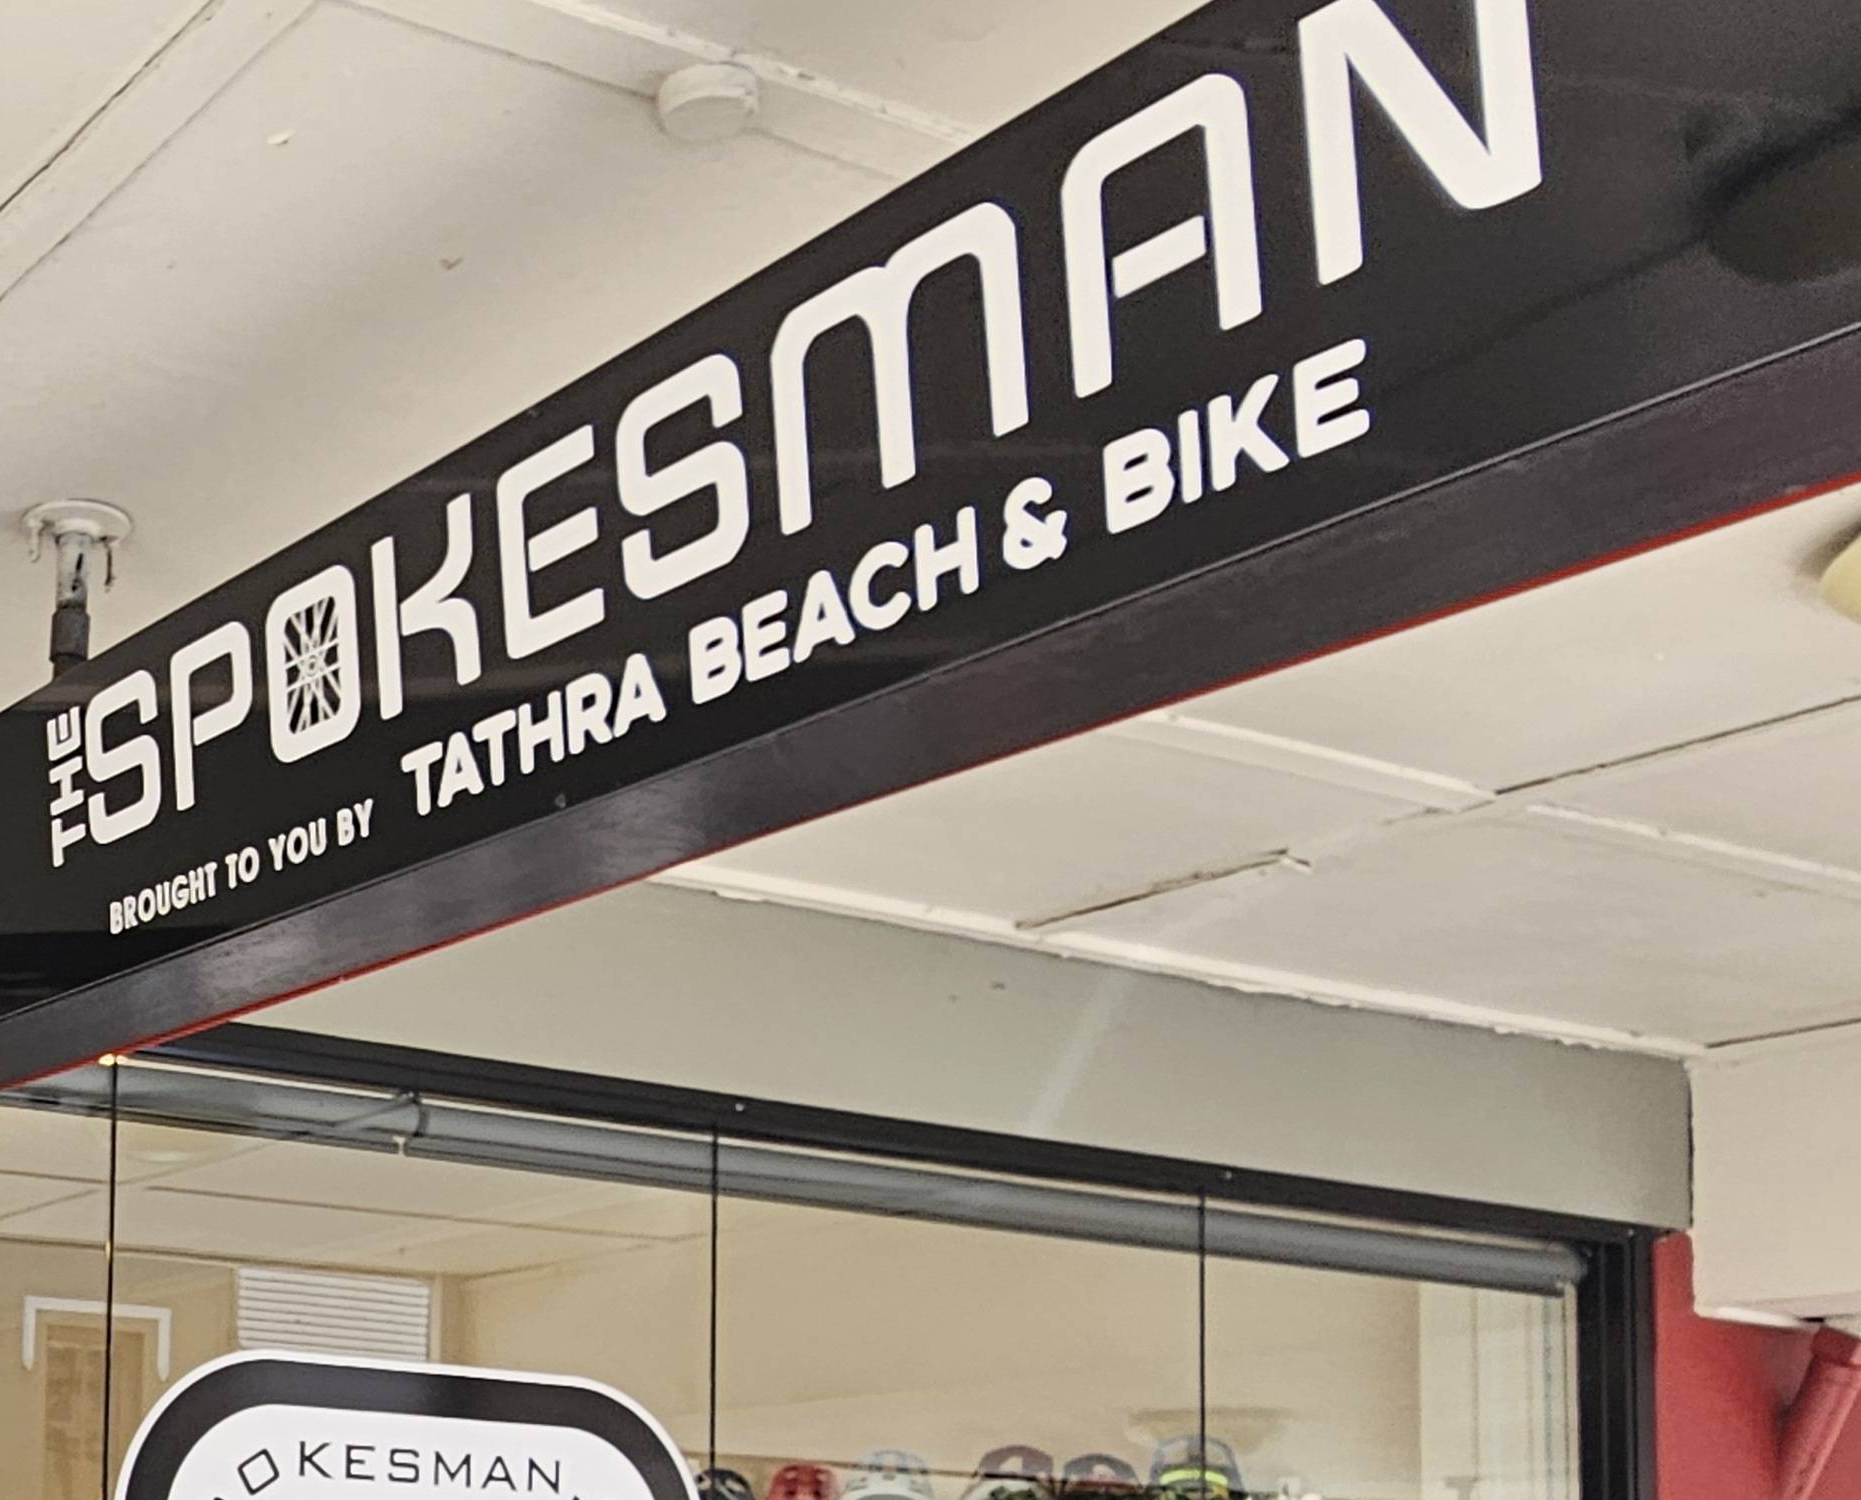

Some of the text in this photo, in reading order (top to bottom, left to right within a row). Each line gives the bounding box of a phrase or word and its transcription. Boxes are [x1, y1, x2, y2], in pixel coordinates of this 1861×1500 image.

[46, 0, 1543, 868] THE SPOKESMAN
[108, 337, 1371, 935] BROUGHT TO YOU BY TATHRA BEACH & BIKE
